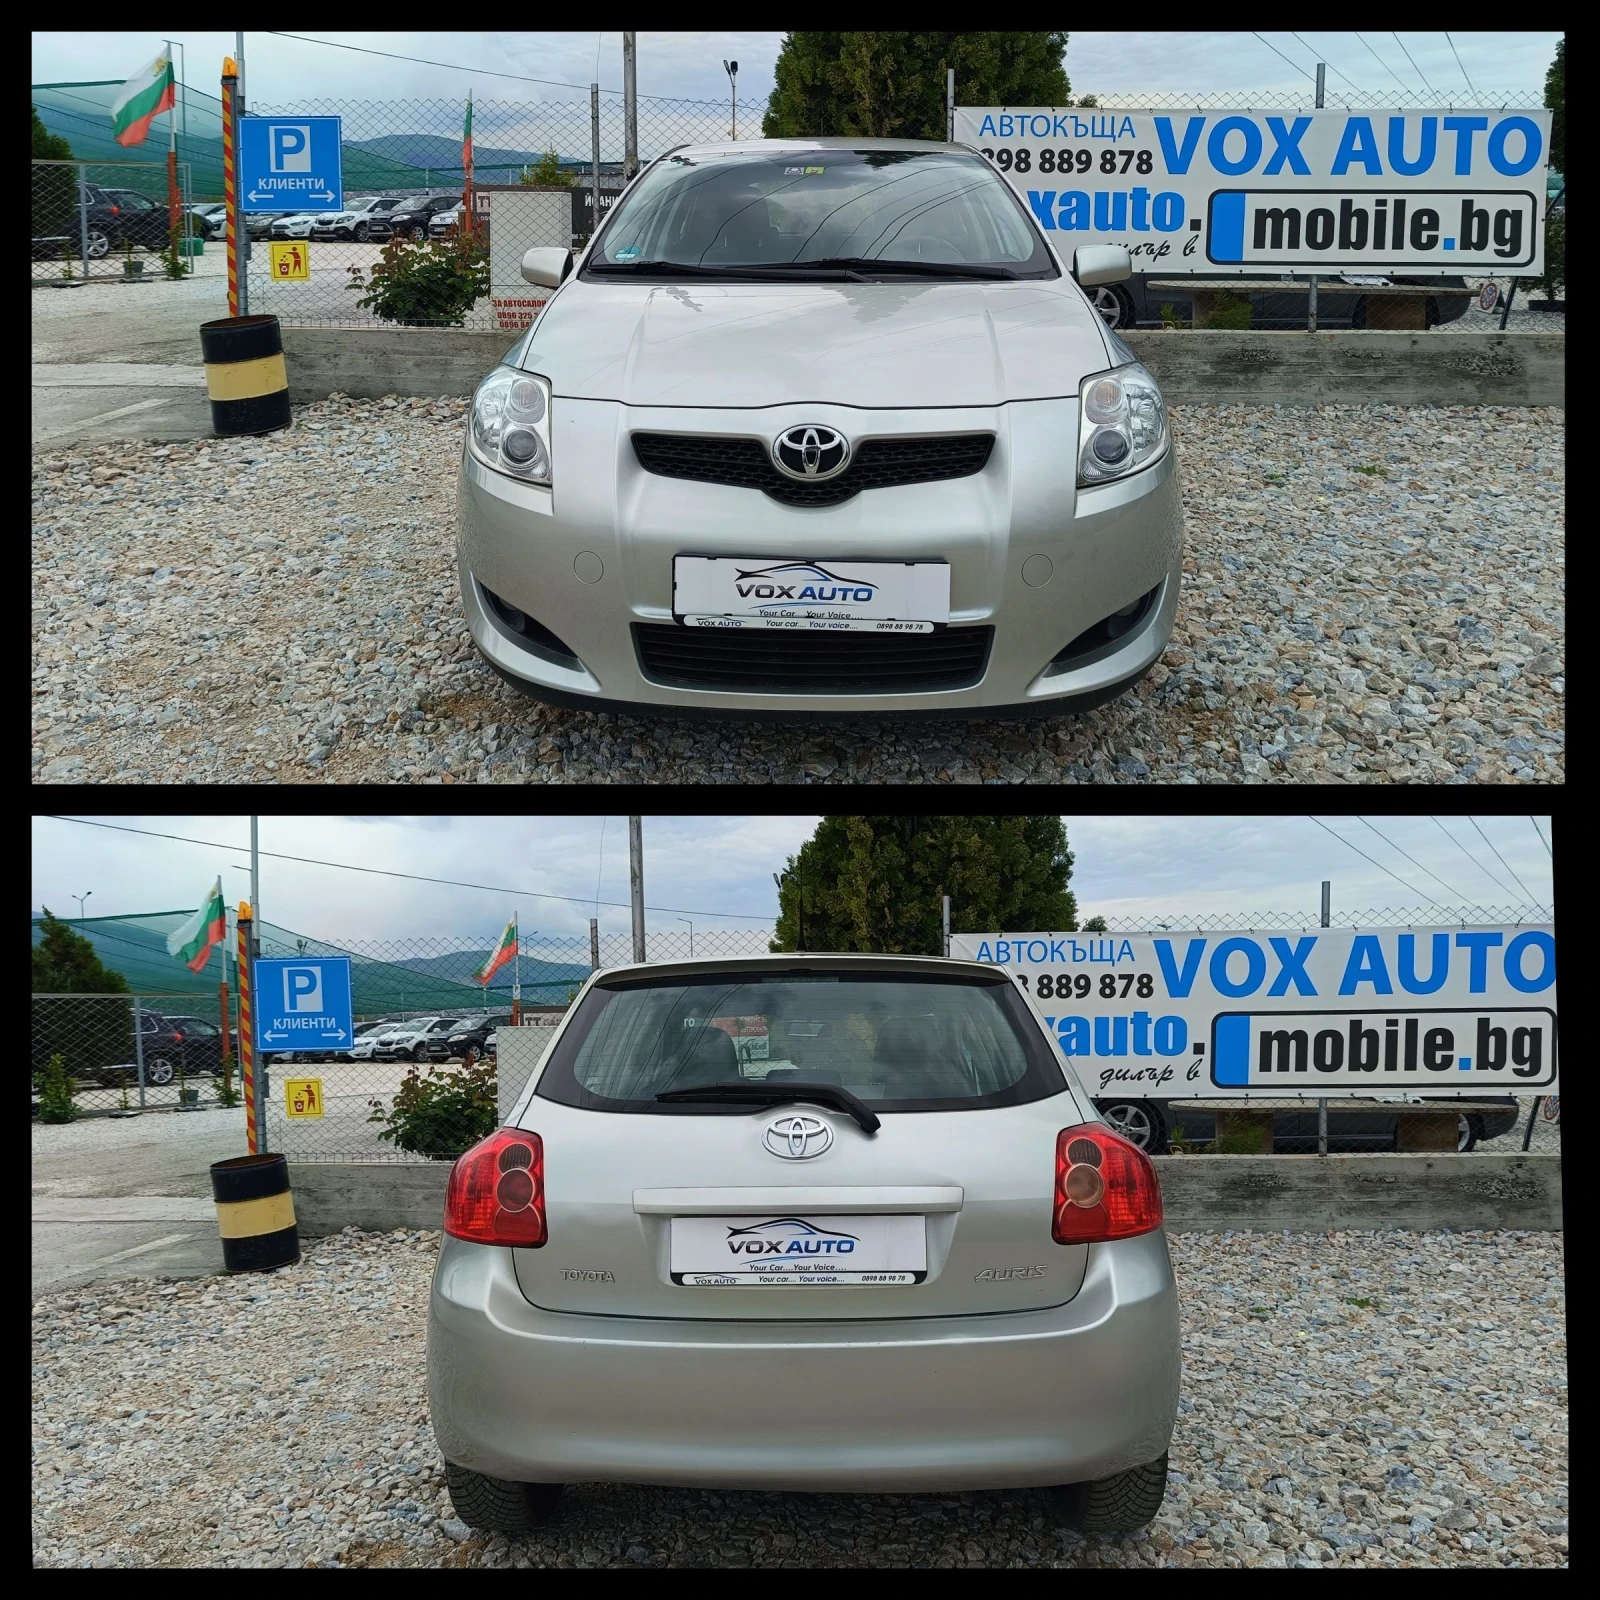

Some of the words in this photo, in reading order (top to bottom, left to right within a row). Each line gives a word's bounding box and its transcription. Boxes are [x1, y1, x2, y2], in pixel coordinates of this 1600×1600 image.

[978, 114, 1136, 142] АВТОКЪЩА
[273, 127, 306, 170] P
[1153, 115, 1314, 176] VOX
[1330, 115, 1543, 177] AUTO
[1038, 148, 1093, 174] 889
[1099, 149, 1153, 175] 878
[258, 178, 325, 190] КЛИЕНТИ
[1252, 198, 1524, 259] mobile.bg
[492, 299, 502, 308] ЗА
[759, 609, 778, 617] Your
[766, 619, 784, 627] Your
[809, 620, 827, 628] Your
[876, 622, 893, 630] 0898
[976, 939, 1136, 967] АВТОКЪЩА
[1152, 936, 1319, 998] VOX
[1337, 930, 1556, 996] AUTO
[287, 968, 318, 1011] P
[1036, 973, 1092, 999] 889
[1098, 973, 1154, 999] 878
[273, 1017, 336, 1030] КЛИЕНТИ
[1043, 1011, 1205, 1057] auto.
[1258, 1017, 1543, 1078] mobile.bg
[1099, 1064, 1175, 1090] дилър
[560, 1268, 615, 1283] TOYOTA
[758, 1275, 775, 1283] Your
[798, 1275, 815, 1283] Your
[974, 1264, 1048, 1282] AURIS
